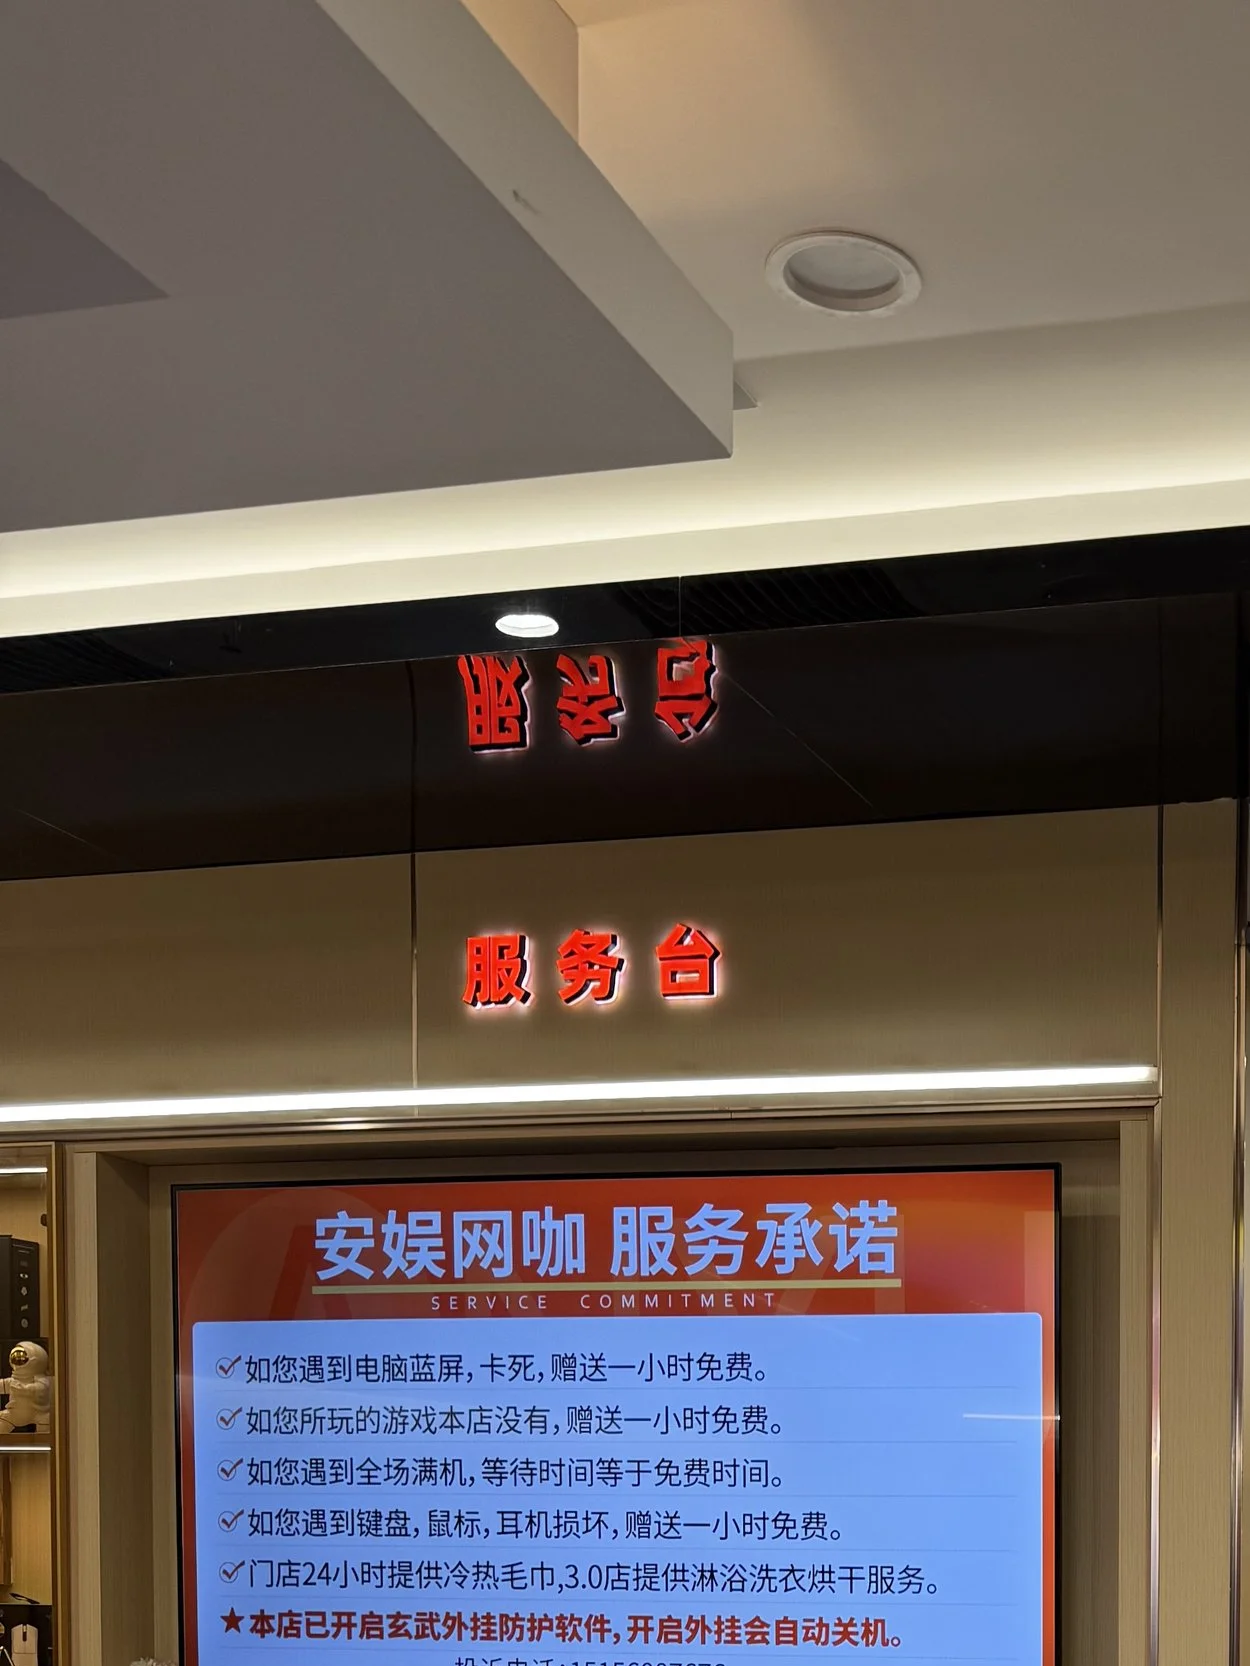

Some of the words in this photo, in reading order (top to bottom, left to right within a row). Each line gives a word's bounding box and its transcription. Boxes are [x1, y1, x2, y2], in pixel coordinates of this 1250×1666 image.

[462, 923, 721, 1007] 服务台
[314, 1207, 586, 1280] 安娱网咖
[610, 1200, 898, 1276] 服务承诺
[431, 1294, 550, 1310] SERVICE
[581, 1292, 776, 1309] COMMITMENT
